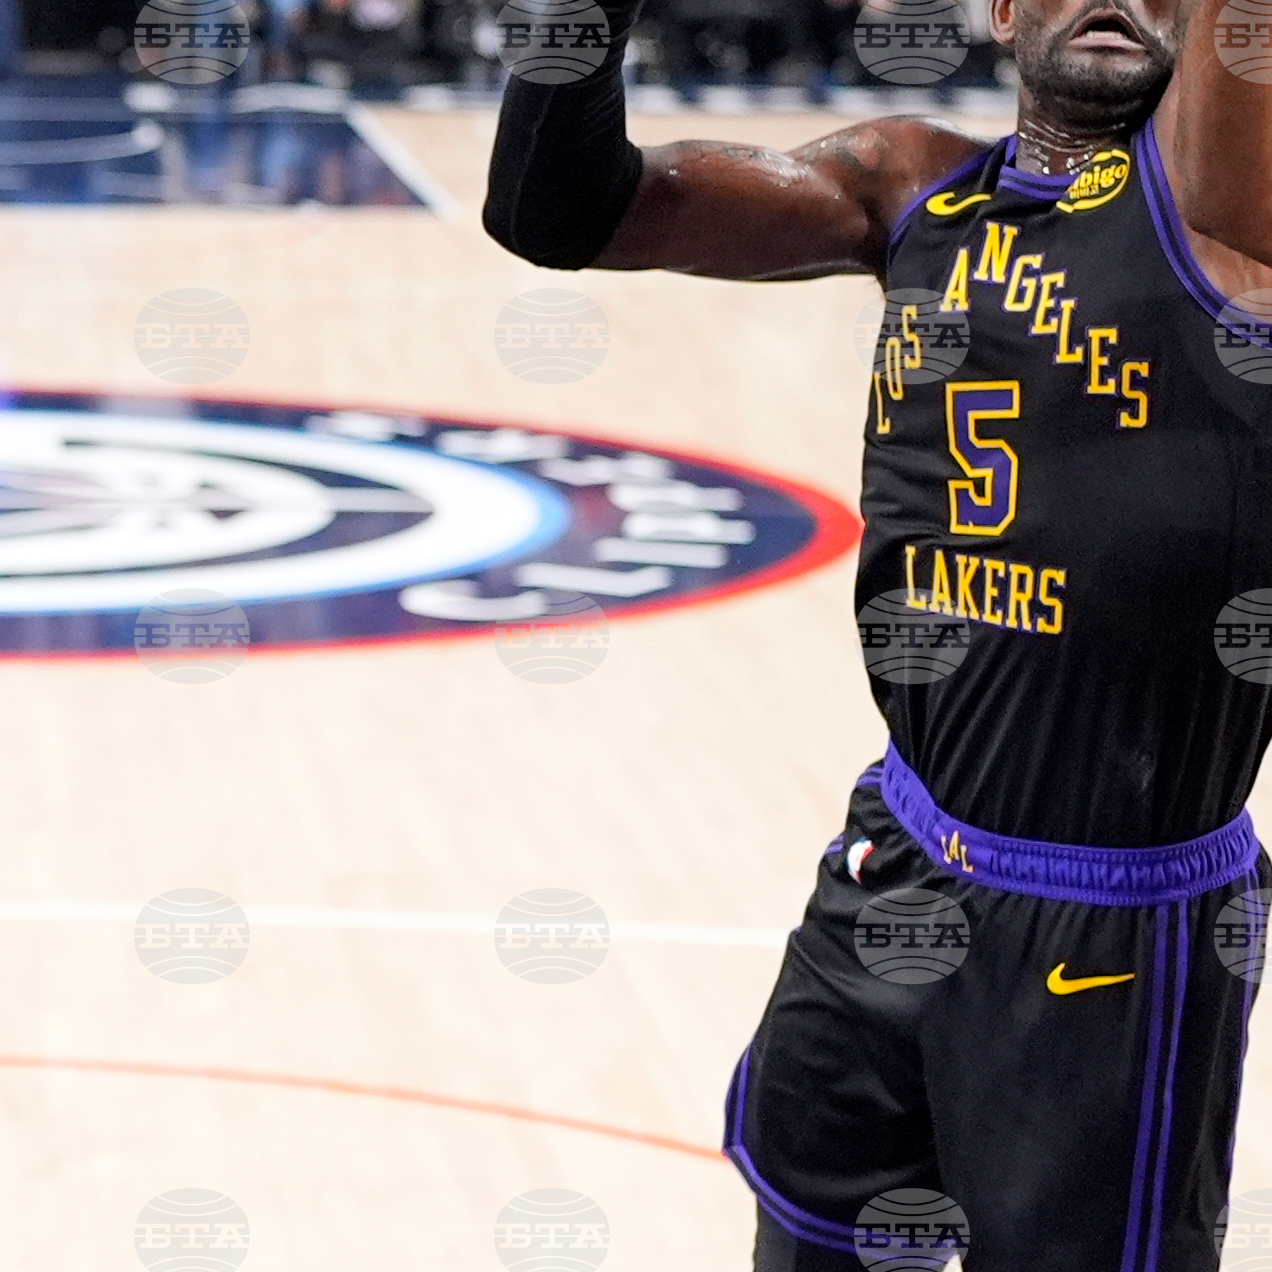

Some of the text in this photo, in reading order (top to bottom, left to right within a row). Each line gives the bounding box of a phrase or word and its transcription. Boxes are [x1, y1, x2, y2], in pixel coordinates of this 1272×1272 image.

[873, 221, 1150, 434] LOS ANGELES
[945, 380, 1020, 536] 5
[905, 544, 1067, 635] LAKERS
